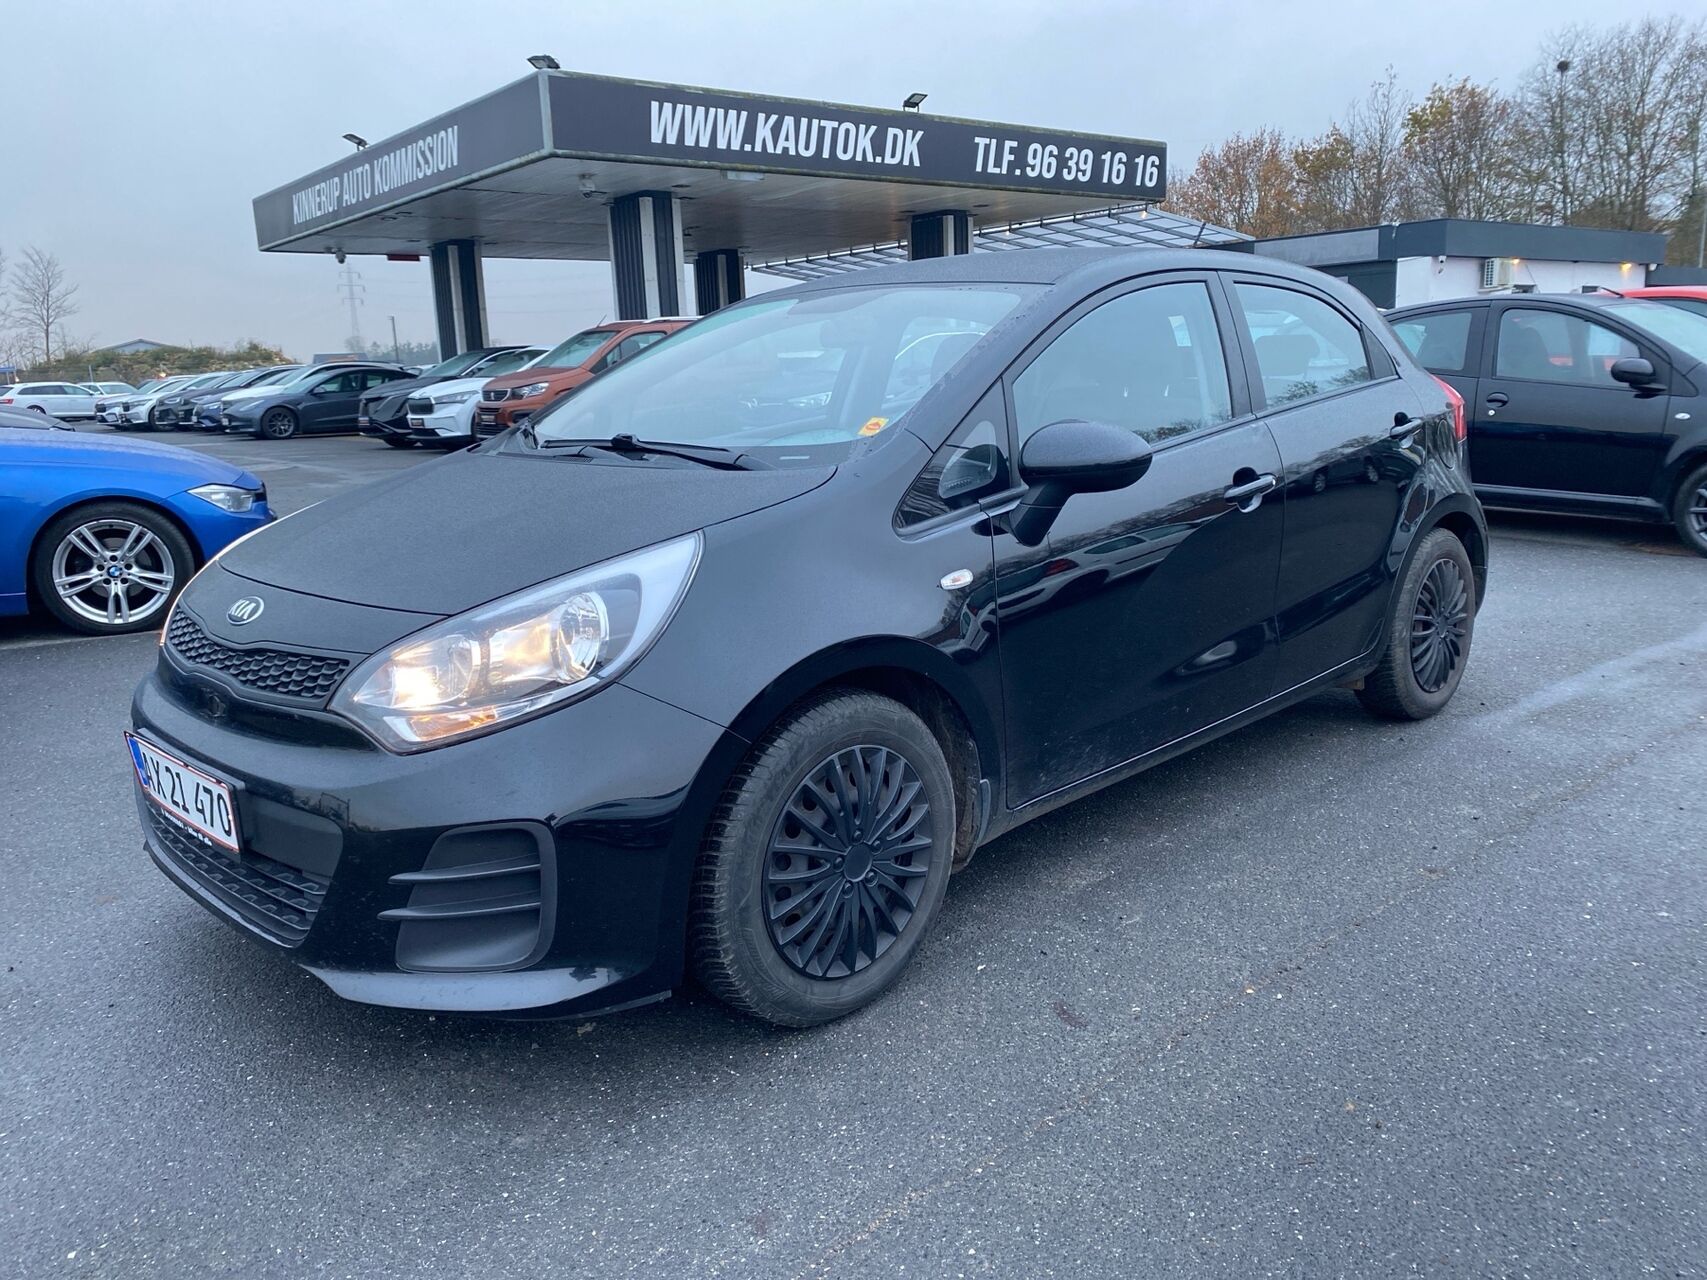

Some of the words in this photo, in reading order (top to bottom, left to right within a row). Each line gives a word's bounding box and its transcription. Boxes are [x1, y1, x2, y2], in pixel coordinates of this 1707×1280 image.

[650, 100, 924, 167] WWW.KAUTOK.DK
[974, 136, 1022, 176] TLF.
[1025, 142, 1059, 179] 96
[1062, 147, 1094, 182] 39
[1101, 151, 1128, 185] 16
[1134, 154, 1160, 188] 16
[292, 177, 341, 225] KINNERUP
[342, 163, 371, 207] AUTO
[374, 125, 459, 196] KOMMISSION
[228, 599, 257, 620] KIA
[142, 752, 167, 800] AX
[165, 766, 190, 815] 21
[195, 782, 232, 838] 470
